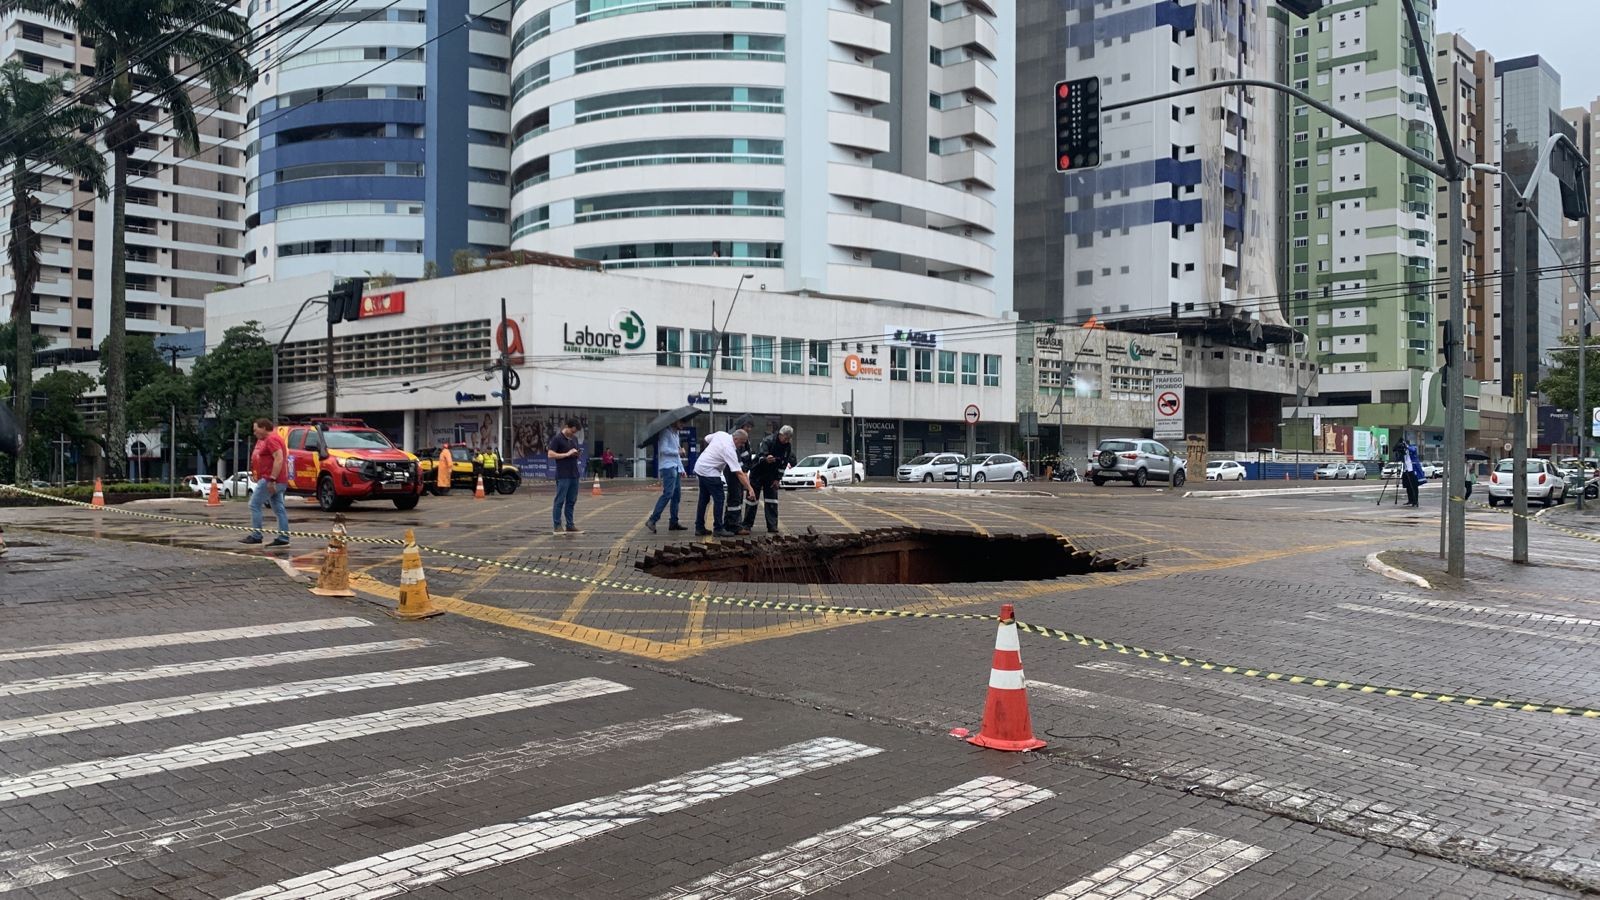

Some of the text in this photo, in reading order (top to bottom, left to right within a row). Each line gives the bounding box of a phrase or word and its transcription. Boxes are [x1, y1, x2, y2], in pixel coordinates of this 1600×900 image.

[564, 322, 621, 348] Labore
[584, 347, 620, 355] OCUPACIONAL
[860, 367, 882, 375] OFFICE
